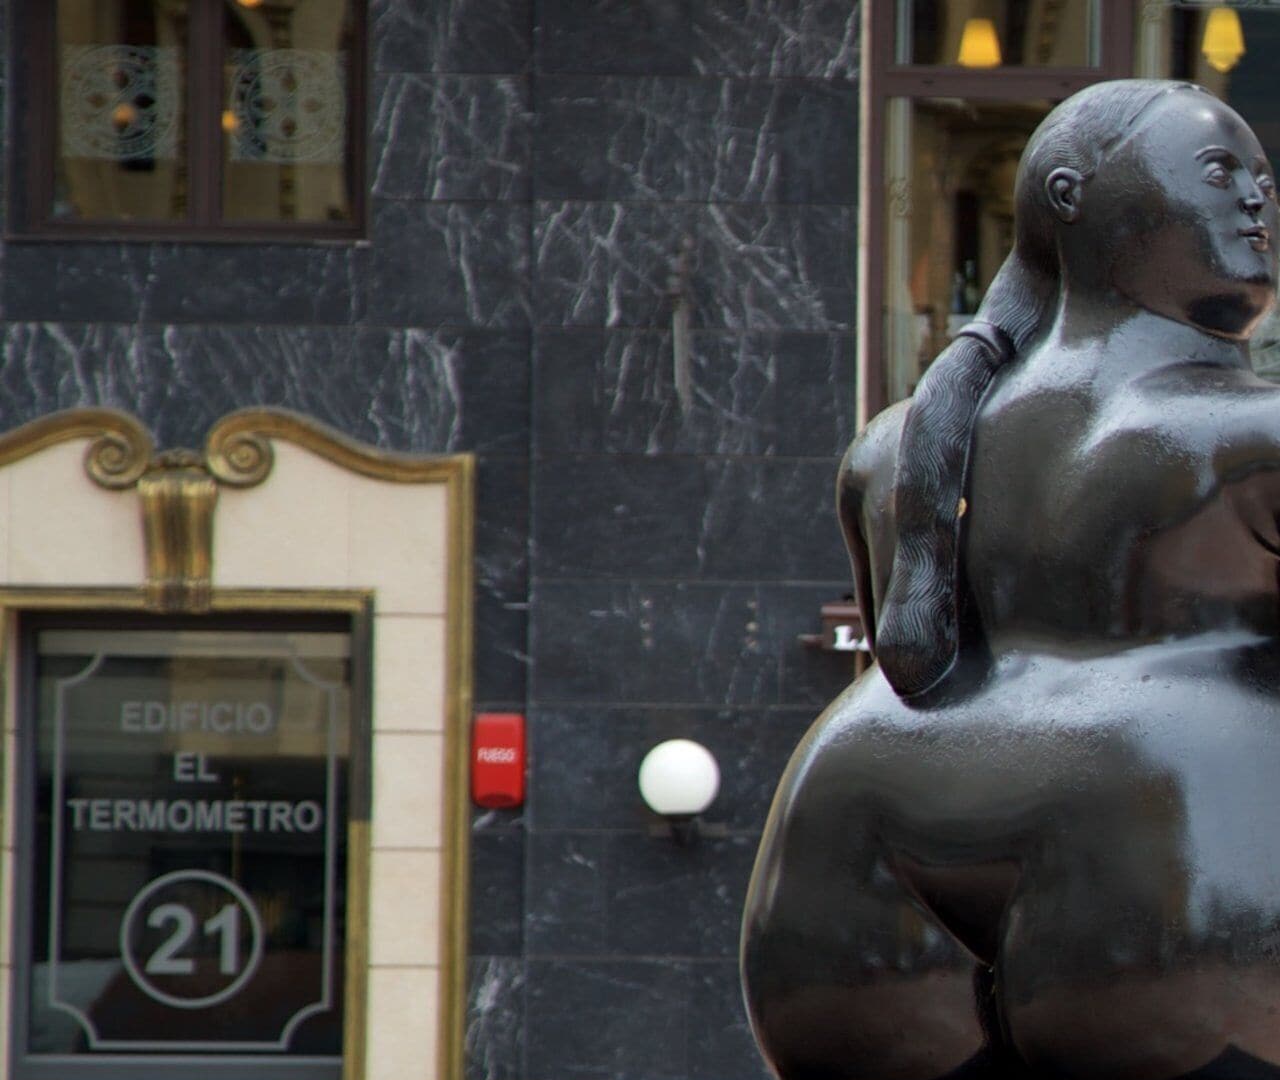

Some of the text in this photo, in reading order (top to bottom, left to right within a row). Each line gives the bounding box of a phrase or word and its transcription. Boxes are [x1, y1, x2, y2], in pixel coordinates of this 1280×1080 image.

[120, 701, 274, 733] EDIFICIO
[173, 752, 219, 783] EL
[68, 800, 321, 832] TERMOMETRO
[145, 903, 241, 976] 21
